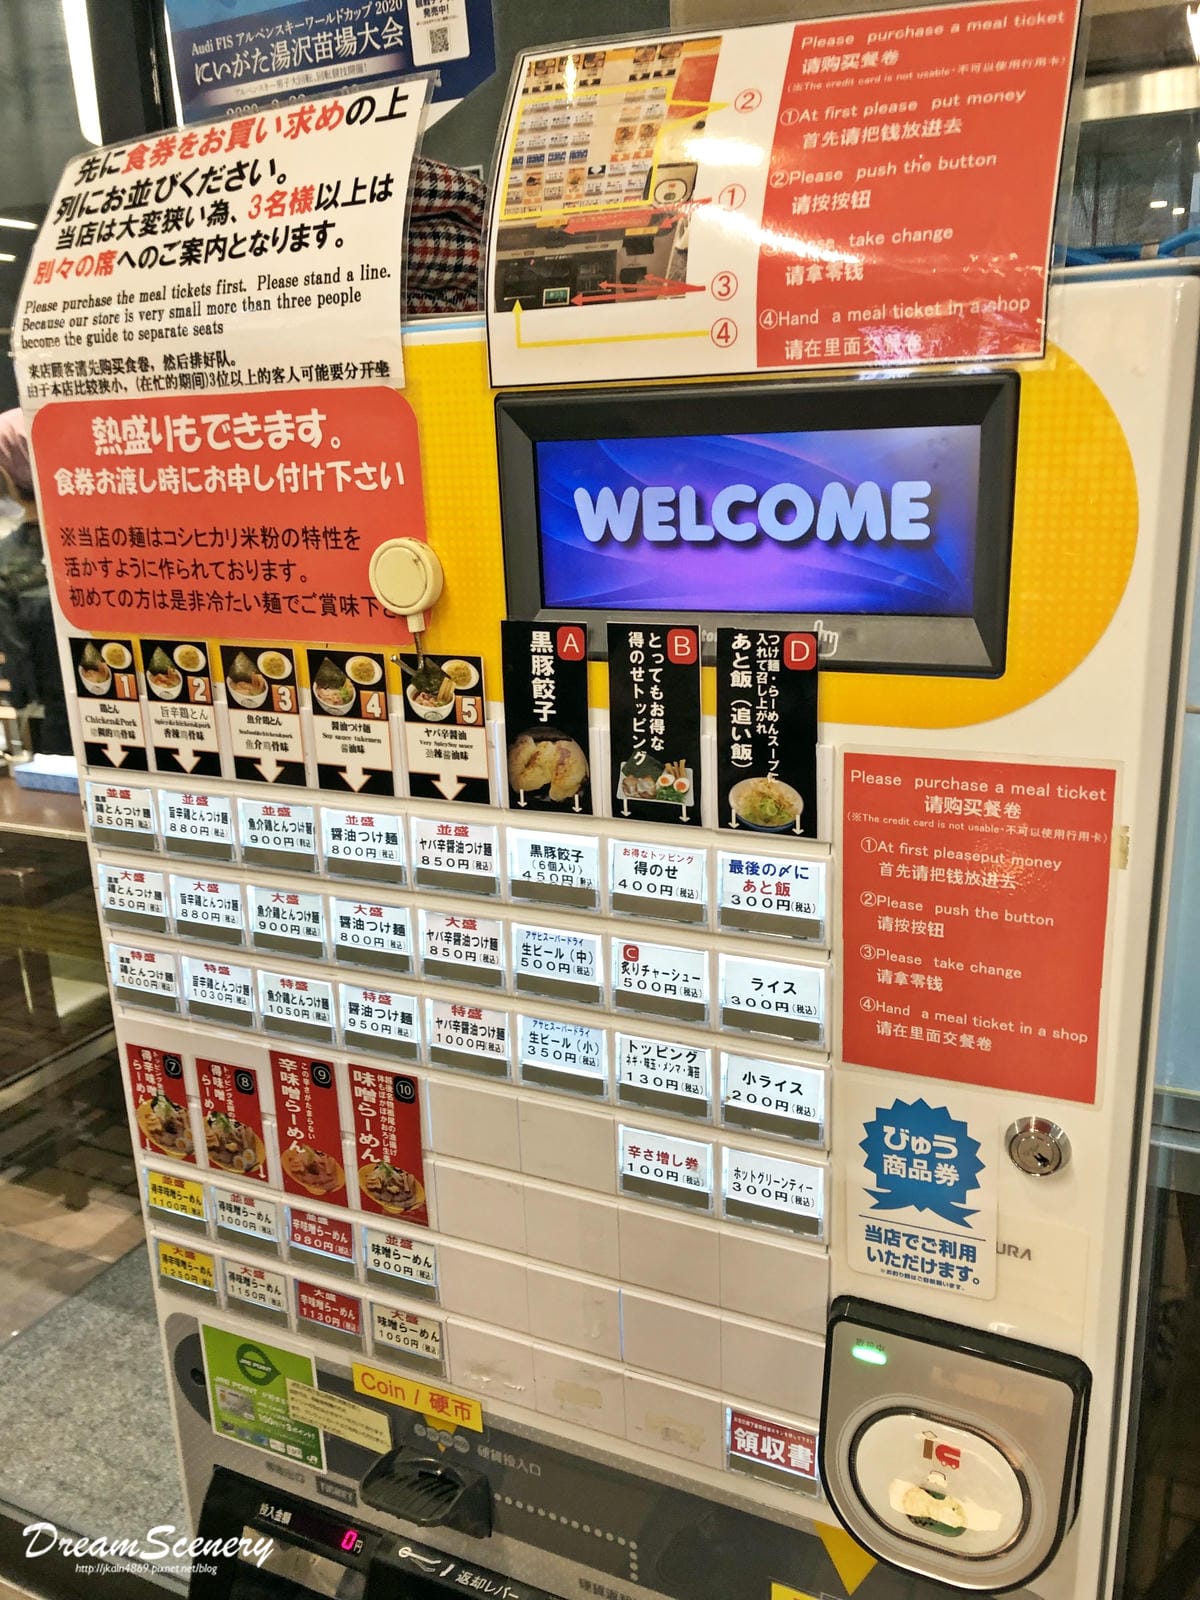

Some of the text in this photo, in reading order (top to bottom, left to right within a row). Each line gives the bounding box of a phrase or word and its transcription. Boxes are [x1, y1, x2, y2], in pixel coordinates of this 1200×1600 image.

[191, 43, 214, 56] Audi
[216, 36, 233, 52] FIS
[237, 4, 371, 47] アルペンスキーワールドカップ
[195, 17, 404, 86] にいがた湯沢苗場大会
[74, 92, 408, 186] 先に食券をお買い求めの上
[803, 118, 963, 149] 首先请把钱放进去
[53, 158, 288, 225] 列にお並びください。
[792, 190, 871, 215] 请按按钮
[55, 174, 394, 250] 当店は大変狭い為、3名様以上は
[34, 219, 345, 284] 別々の席へのご案内となります。
[25, 265, 391, 315] Please purchase the meal tickets first. Please stand a line.
[22, 287, 362, 332] Because our store is very small more than three people
[22, 321, 224, 350] become the guide to separate seats
[92, 408, 341, 456] 熱盛りもできます。
[54, 460, 404, 496] 食券お渡し時にお申し付け下さい
[573, 480, 932, 542] WELCOME
[65, 557, 308, 583] 活かすように作られております。
[562, 633, 580, 653] A
[674, 636, 691, 656] B
[791, 640, 810, 662] D
[119, 675, 131, 698] 1
[530, 631, 557, 722] 黒豚餃子
[755, 633, 768, 735] 入れて召し上がれ
[192, 677, 208, 702] 2
[277, 686, 293, 712] 3
[628, 632, 647, 766] 得のせトッピング
[648, 632, 666, 751] とってもお得な
[160, 706, 208, 721] 旨辛鶏とん
[366, 693, 382, 718] 4
[461, 697, 478, 724] 5
[106, 788, 131, 800] 並盛
[851, 770, 1106, 802] Please purchase a meal ticket
[182, 794, 209, 806] 並盛
[261, 806, 292, 818] 並盛
[248, 818, 313, 835] 魚介鶏とんつけ麺
[346, 815, 375, 827] 並盛
[436, 824, 470, 838] 並盛
[883, 815, 965, 832] credit card not
[331, 827, 398, 845] 醤油つけ麺
[419, 838, 493, 857] ヤバ辛醤油つけ麺
[530, 843, 584, 863] 黒豚餃子
[622, 847, 695, 865] お得なトッピング
[899, 841, 929, 857] first
[1011, 856, 1062, 872] money
[120, 871, 145, 883] 大盛
[634, 860, 679, 880] 得のせ
[879, 862, 1017, 890] 首先请把钱放进去
[193, 881, 220, 894] 大盛
[271, 892, 299, 905] 大盛
[743, 879, 791, 898] あと飯
[353, 905, 384, 918] 大盛
[445, 916, 478, 931] 大盛
[935, 902, 1055, 927] push the button
[339, 915, 406, 937] 醤油つけ麺
[877, 915, 945, 939] 请按按钮
[426, 929, 498, 952] ヤバ辛醤油つけ麺
[626, 947, 636, 959] C
[130, 950, 156, 963] 特盛
[934, 957, 1022, 980] take change
[204, 963, 231, 976] 特盛
[620, 962, 701, 982] 炙りチャーシュー
[876, 968, 944, 992] 请拿零钱
[280, 978, 308, 991] 特盛
[751, 977, 797, 995] ライス
[362, 992, 392, 1006] 特盛
[348, 1002, 413, 1025] 醤油つけ麺
[451, 1004, 483, 1020] 特盛
[922, 1009, 1089, 1045] a meal ticket in a shop
[629, 1040, 698, 1063] トッピング
[742, 1072, 803, 1095] 小ライス
[278, 1057, 306, 1153] 辛味噌らーめん
[353, 1070, 381, 1163] 味噌らーめん
[882, 1125, 959, 1160] びゅう
[627, 1145, 698, 1170] 辛さ増し券
[734, 1166, 814, 1192] ホットグリーンティー
[882, 1154, 960, 1187] 商品券
[732, 1181, 814, 1208] 300円(税込)
[292, 1219, 348, 1244] 辛味噌らーめん
[865, 1224, 977, 1264] 当店でご利用
[371, 1243, 432, 1269] 味噌らーめん
[867, 1246, 980, 1285] いただけます。
[377, 1315, 440, 1343] 味噌らーめん
[361, 1371, 473, 1422] Coin 硬币
[734, 1427, 814, 1472] 領収書
[455, 1570, 519, 1599] 返却レバー
